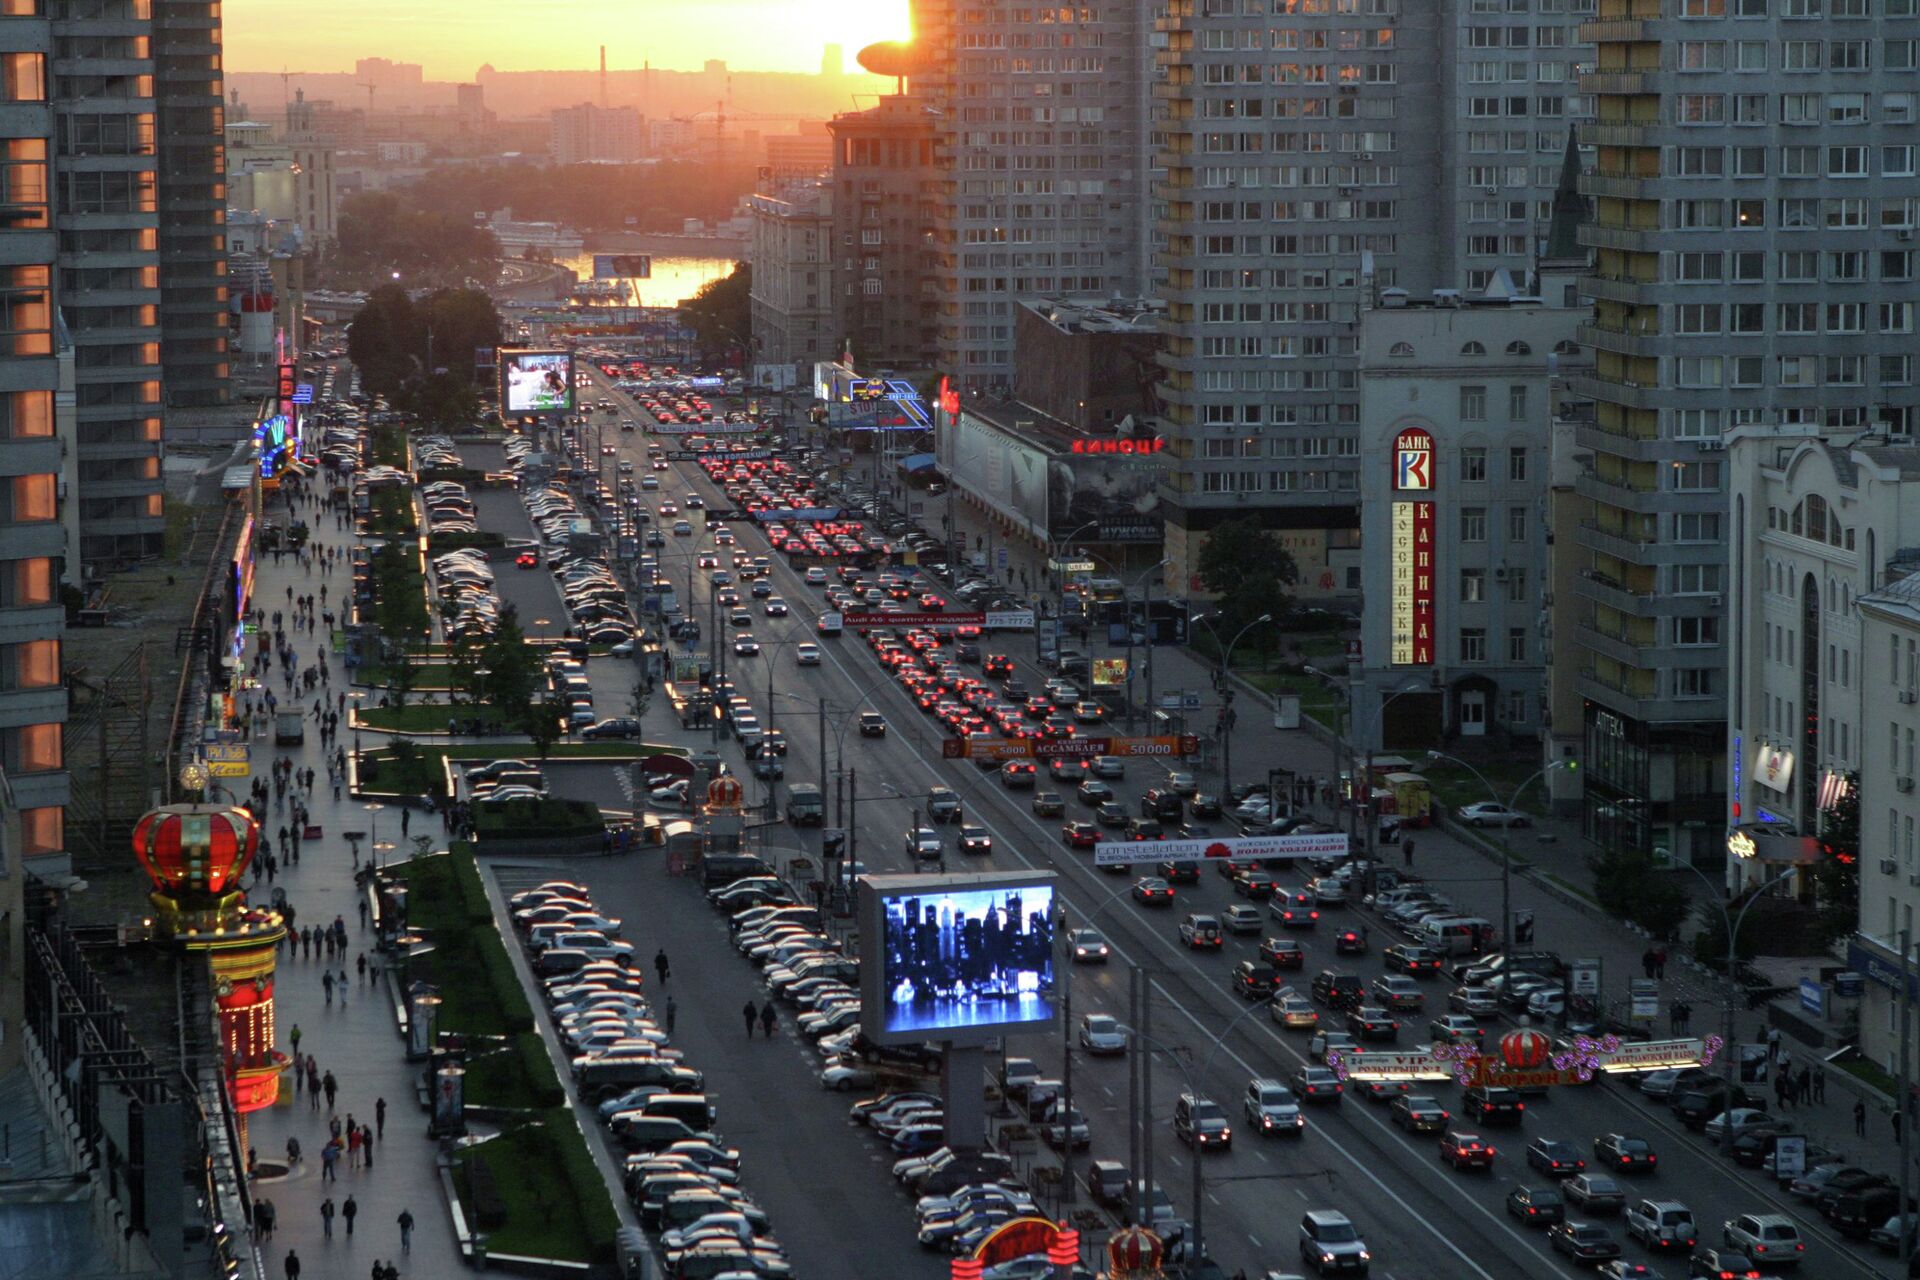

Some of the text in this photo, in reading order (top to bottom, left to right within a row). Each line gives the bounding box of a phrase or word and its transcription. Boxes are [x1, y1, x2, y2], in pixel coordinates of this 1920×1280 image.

[1398, 435, 1431, 449] БАНК
[1398, 503, 1407, 663] РОССИЙСКИЙ
[1418, 503, 1430, 663] КАПИТАЛ
[1596, 709, 1625, 740] АПТЕКА
[1036, 744, 1105, 753] АССАМБЛЕЯ
[1315, 837, 1345, 845] ОДЕЖДА
[1236, 844, 1345, 855] НОВЫЕ КОЛЛЕКЦИИ
[1134, 852, 1163, 860] НОВЫЙ
[1646, 1043, 1688, 1052] СЕРИИ
[1358, 1065, 1420, 1073] РОЗЫГРЫШ
